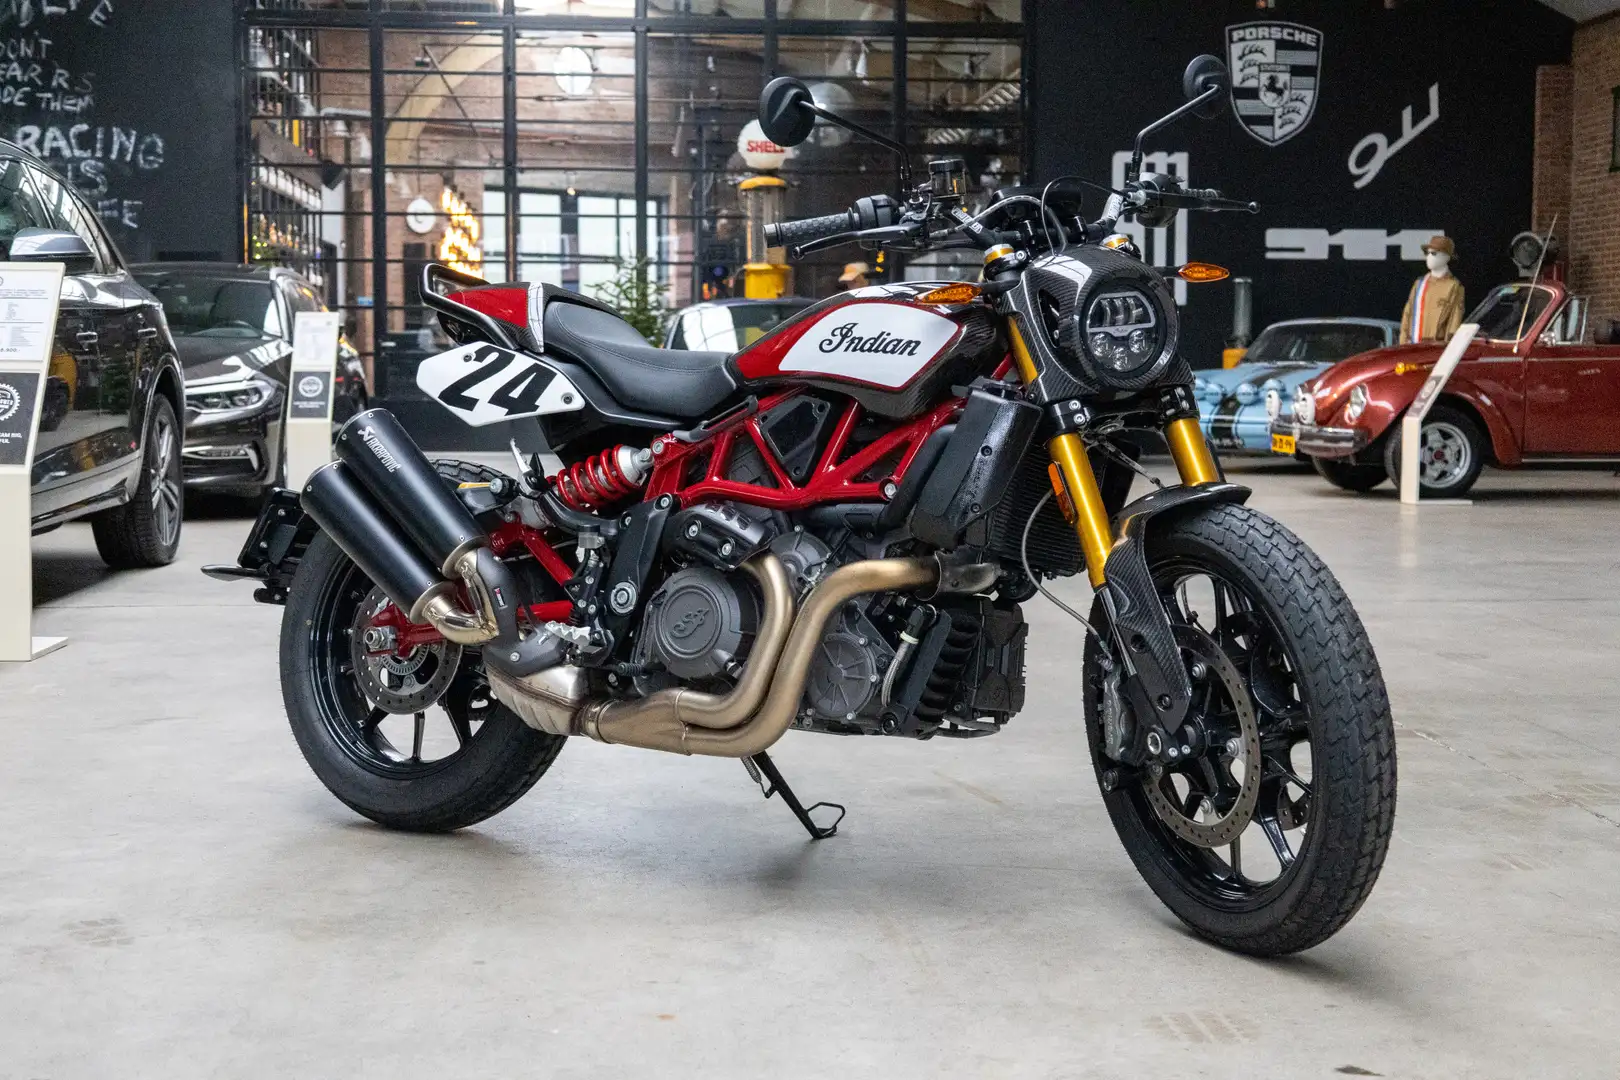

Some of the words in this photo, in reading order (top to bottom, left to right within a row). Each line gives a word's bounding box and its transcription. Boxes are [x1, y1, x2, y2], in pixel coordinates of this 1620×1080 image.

[1231, 26, 1318, 47] PORSCHE
[36, 92, 94, 113] THEM
[16, 123, 165, 170] RACING
[818, 322, 922, 357] Indian
[437, 344, 558, 417] 24
